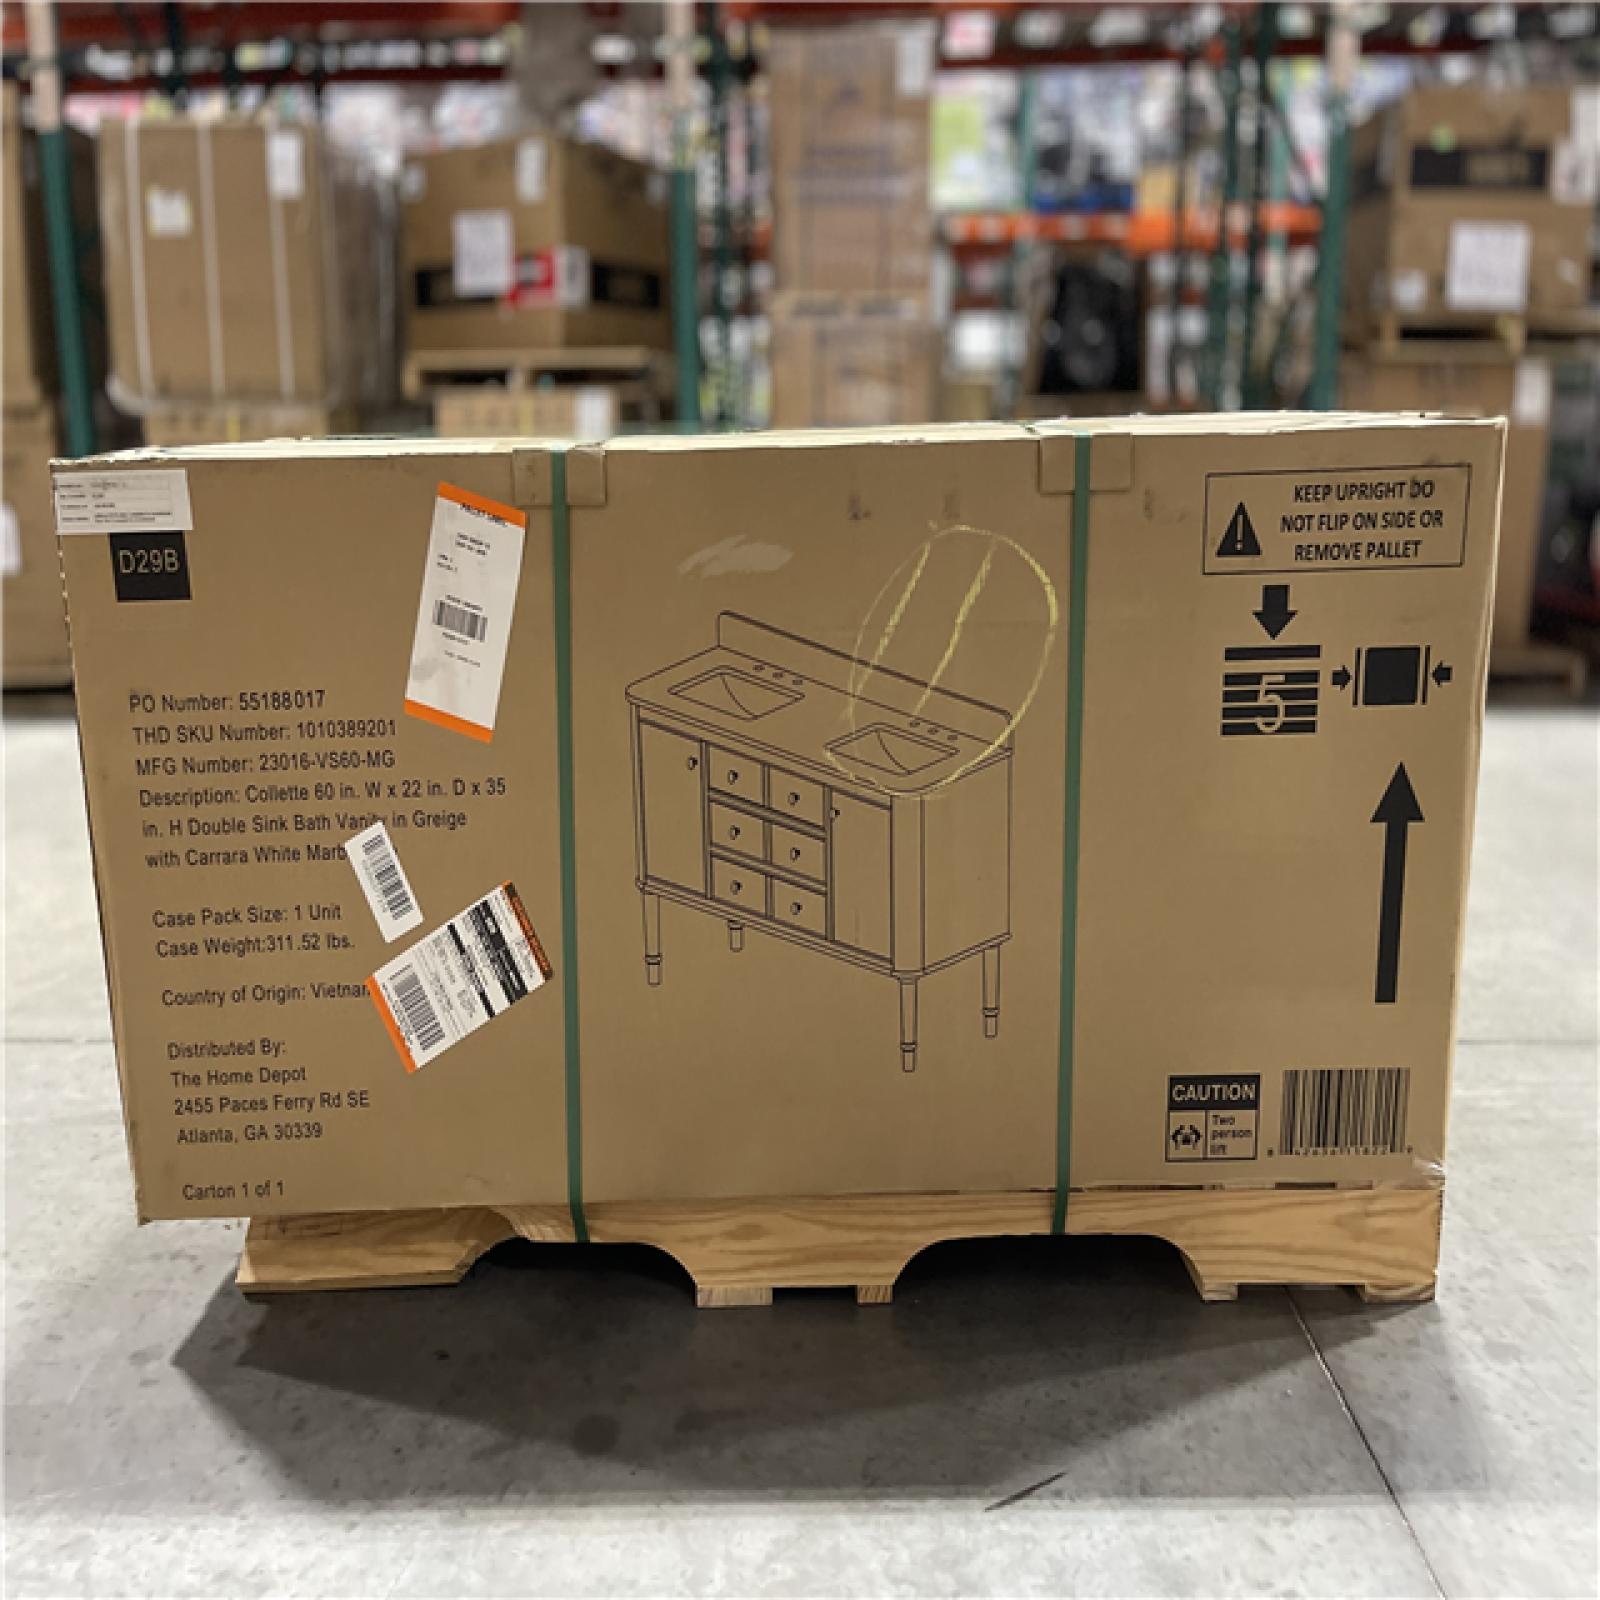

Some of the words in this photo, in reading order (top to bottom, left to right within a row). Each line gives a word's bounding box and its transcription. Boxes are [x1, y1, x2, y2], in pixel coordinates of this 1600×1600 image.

[1294, 484, 1332, 502] KEEP
[1336, 482, 1406, 500] UPRIGHT
[1410, 480, 1434, 498] DO
[1280, 514, 1314, 532] NOT
[1318, 512, 1347, 530] FLIP
[1353, 512, 1378, 530] ON
[1382, 510, 1415, 528] SIDE
[1420, 510, 1444, 526] OR
[120, 548, 180, 573] D29B
[1294, 543, 1360, 560] REMOVE
[1367, 540, 1422, 558] PALLET
[129, 694, 154, 712] PO
[162, 692, 232, 712] Number:
[240, 690, 325, 710] 55188017
[133, 726, 170, 744] THD
[177, 724, 212, 743] SKU
[221, 722, 290, 741] Number:
[297, 720, 396, 739] 1010389201
[136, 758, 176, 776] MFG
[183, 756, 252, 774] Number:
[259, 751, 395, 771] 23016-VS60-MG
[140, 788, 239, 808] Description:
[245, 784, 308, 802] Collette
[314, 783, 334, 801] 60
[340, 782, 359, 800] in.
[365, 782, 381, 799] W
[387, 785, 398, 798] x
[402, 780, 421, 798] 22
[427, 780, 447, 796] in.
[453, 779, 465, 796] D
[470, 782, 481, 796] x
[486, 777, 506, 795] 35
[142, 820, 162, 838] in.
[169, 820, 183, 836] H
[189, 818, 245, 835] Double
[252, 816, 287, 833] Sink
[295, 814, 330, 831] Bath
[393, 811, 407, 828] in
[413, 810, 466, 830] Greige
[146, 850, 180, 868] with
[185, 847, 248, 866] Carrara
[254, 845, 301, 863] White
[152, 909, 196, 928] Case
[202, 907, 242, 926] Pack
[248, 906, 288, 924] Size:
[294, 906, 301, 921] 1
[309, 904, 341, 921] Unit
[156, 939, 198, 958] Case
[204, 935, 320, 957] Weight:311.52
[327, 933, 355, 950] lbs.
[162, 987, 225, 1007] Country
[232, 985, 246, 1002] of
[253, 985, 305, 1004] Origin:
[168, 1039, 255, 1060] Distributed
[260, 1038, 286, 1058] By:
[171, 1071, 201, 1088] The
[208, 1069, 253, 1085] Home
[260, 1067, 306, 1086] Depot
[175, 1098, 213, 1116] 2455
[220, 1096, 268, 1113] Paces
[275, 1094, 315, 1113] Ferry
[320, 1092, 341, 1108] Rd
[347, 1090, 370, 1108] SE
[1172, 1084, 1255, 1101] CAUTION
[1212, 1115, 1235, 1125] Two
[177, 1127, 238, 1145] Atlanta,
[245, 1125, 268, 1141] GA
[275, 1123, 323, 1140] 30339
[1212, 1130, 1252, 1139] person
[182, 1184, 235, 1201] Carton
[242, 1183, 248, 1198] 1
[255, 1182, 270, 1197] of
[277, 1181, 283, 1196] 1
